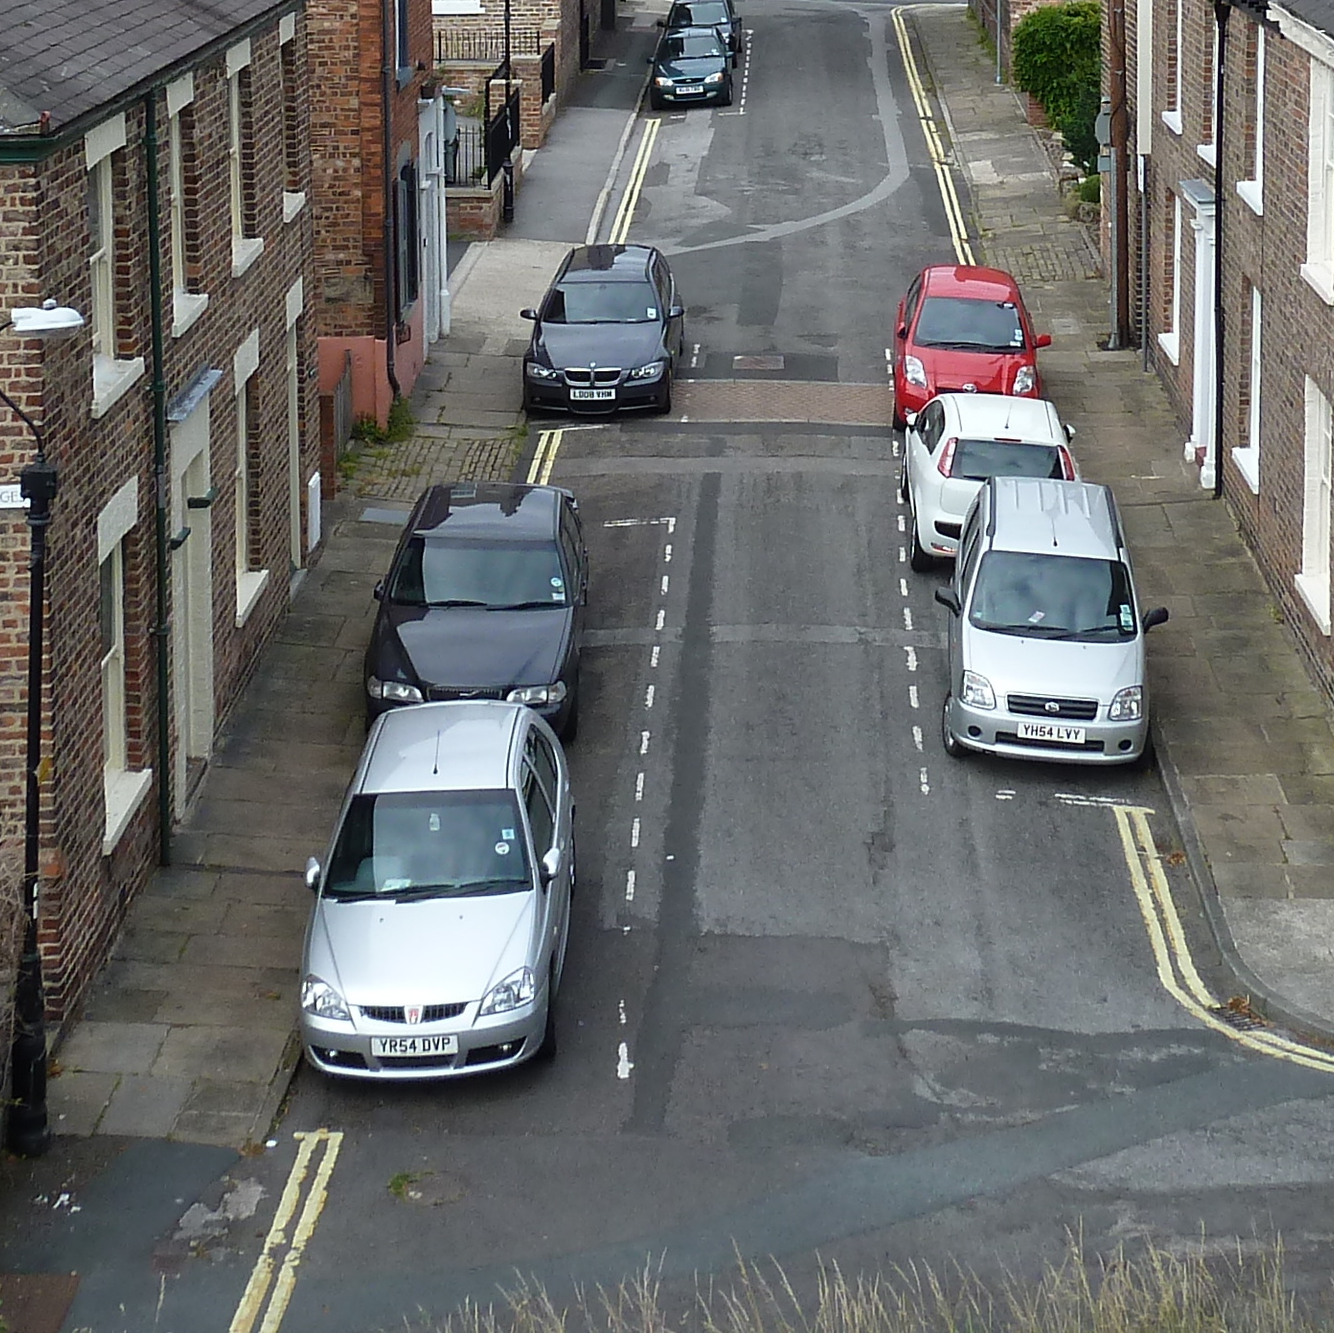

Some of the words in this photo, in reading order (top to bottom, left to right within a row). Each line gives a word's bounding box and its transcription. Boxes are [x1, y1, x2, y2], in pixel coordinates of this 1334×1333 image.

[1023, 724, 1053, 738] YH54
[1057, 728, 1081, 740] LVY
[379, 1039, 417, 1053] YR54
[422, 1037, 451, 1051] DVP
